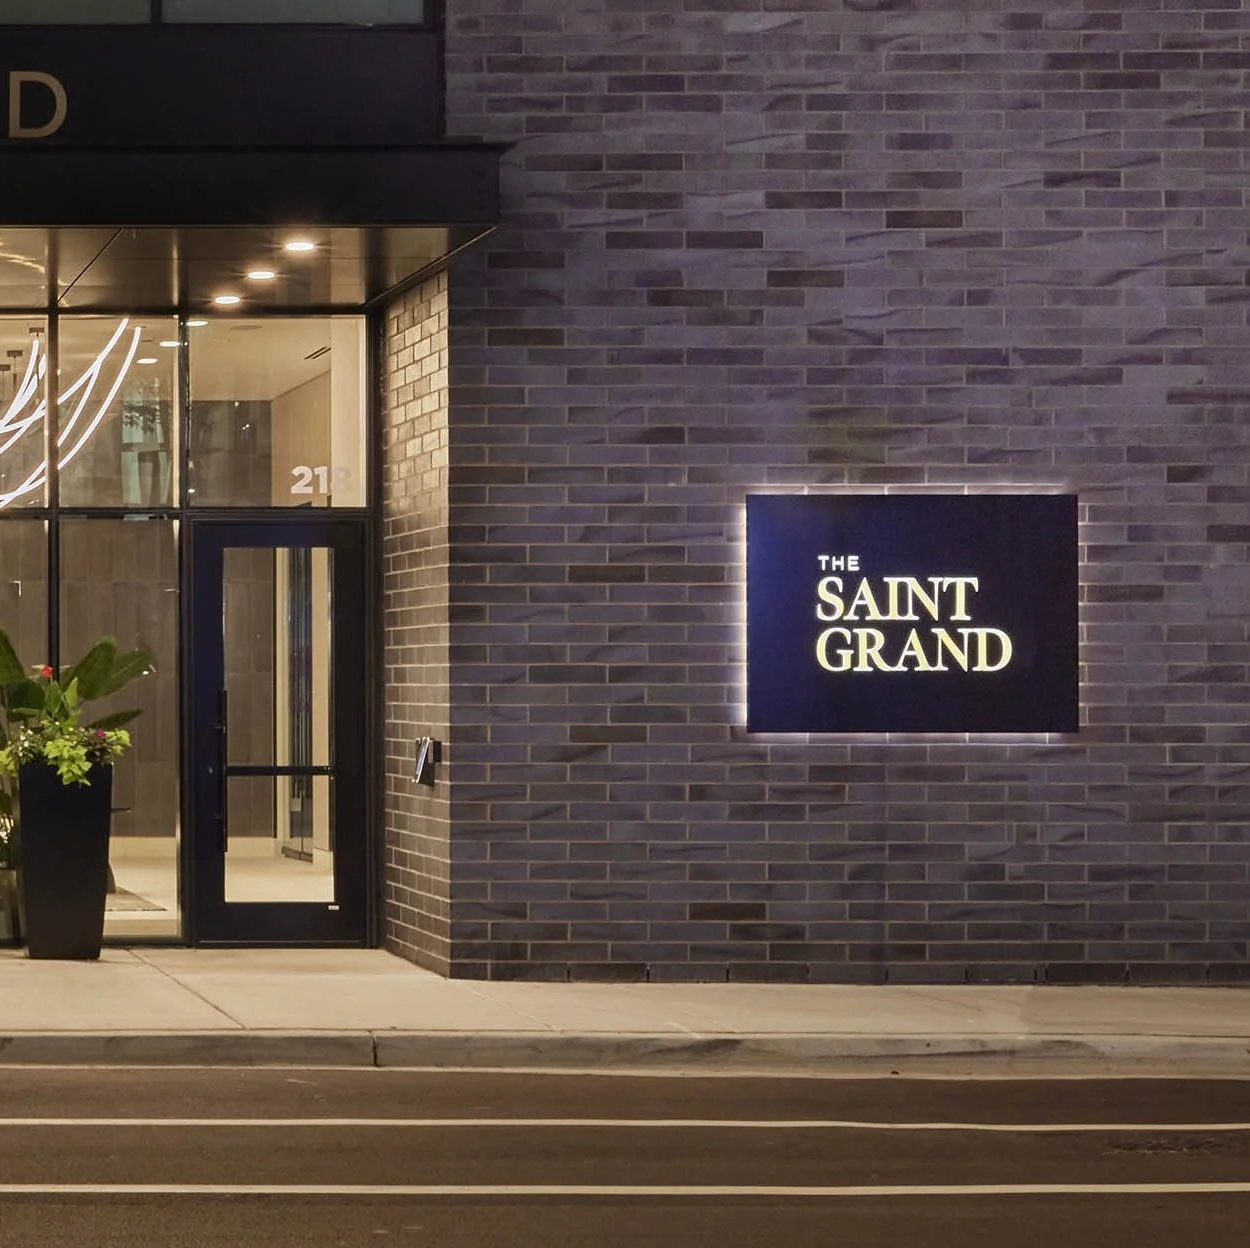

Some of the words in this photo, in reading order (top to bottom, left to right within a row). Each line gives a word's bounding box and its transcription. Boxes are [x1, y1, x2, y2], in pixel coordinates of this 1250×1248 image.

[818, 555, 860, 571] THE
[816, 576, 979, 622] SAINT
[816, 627, 1013, 672] GRAND
